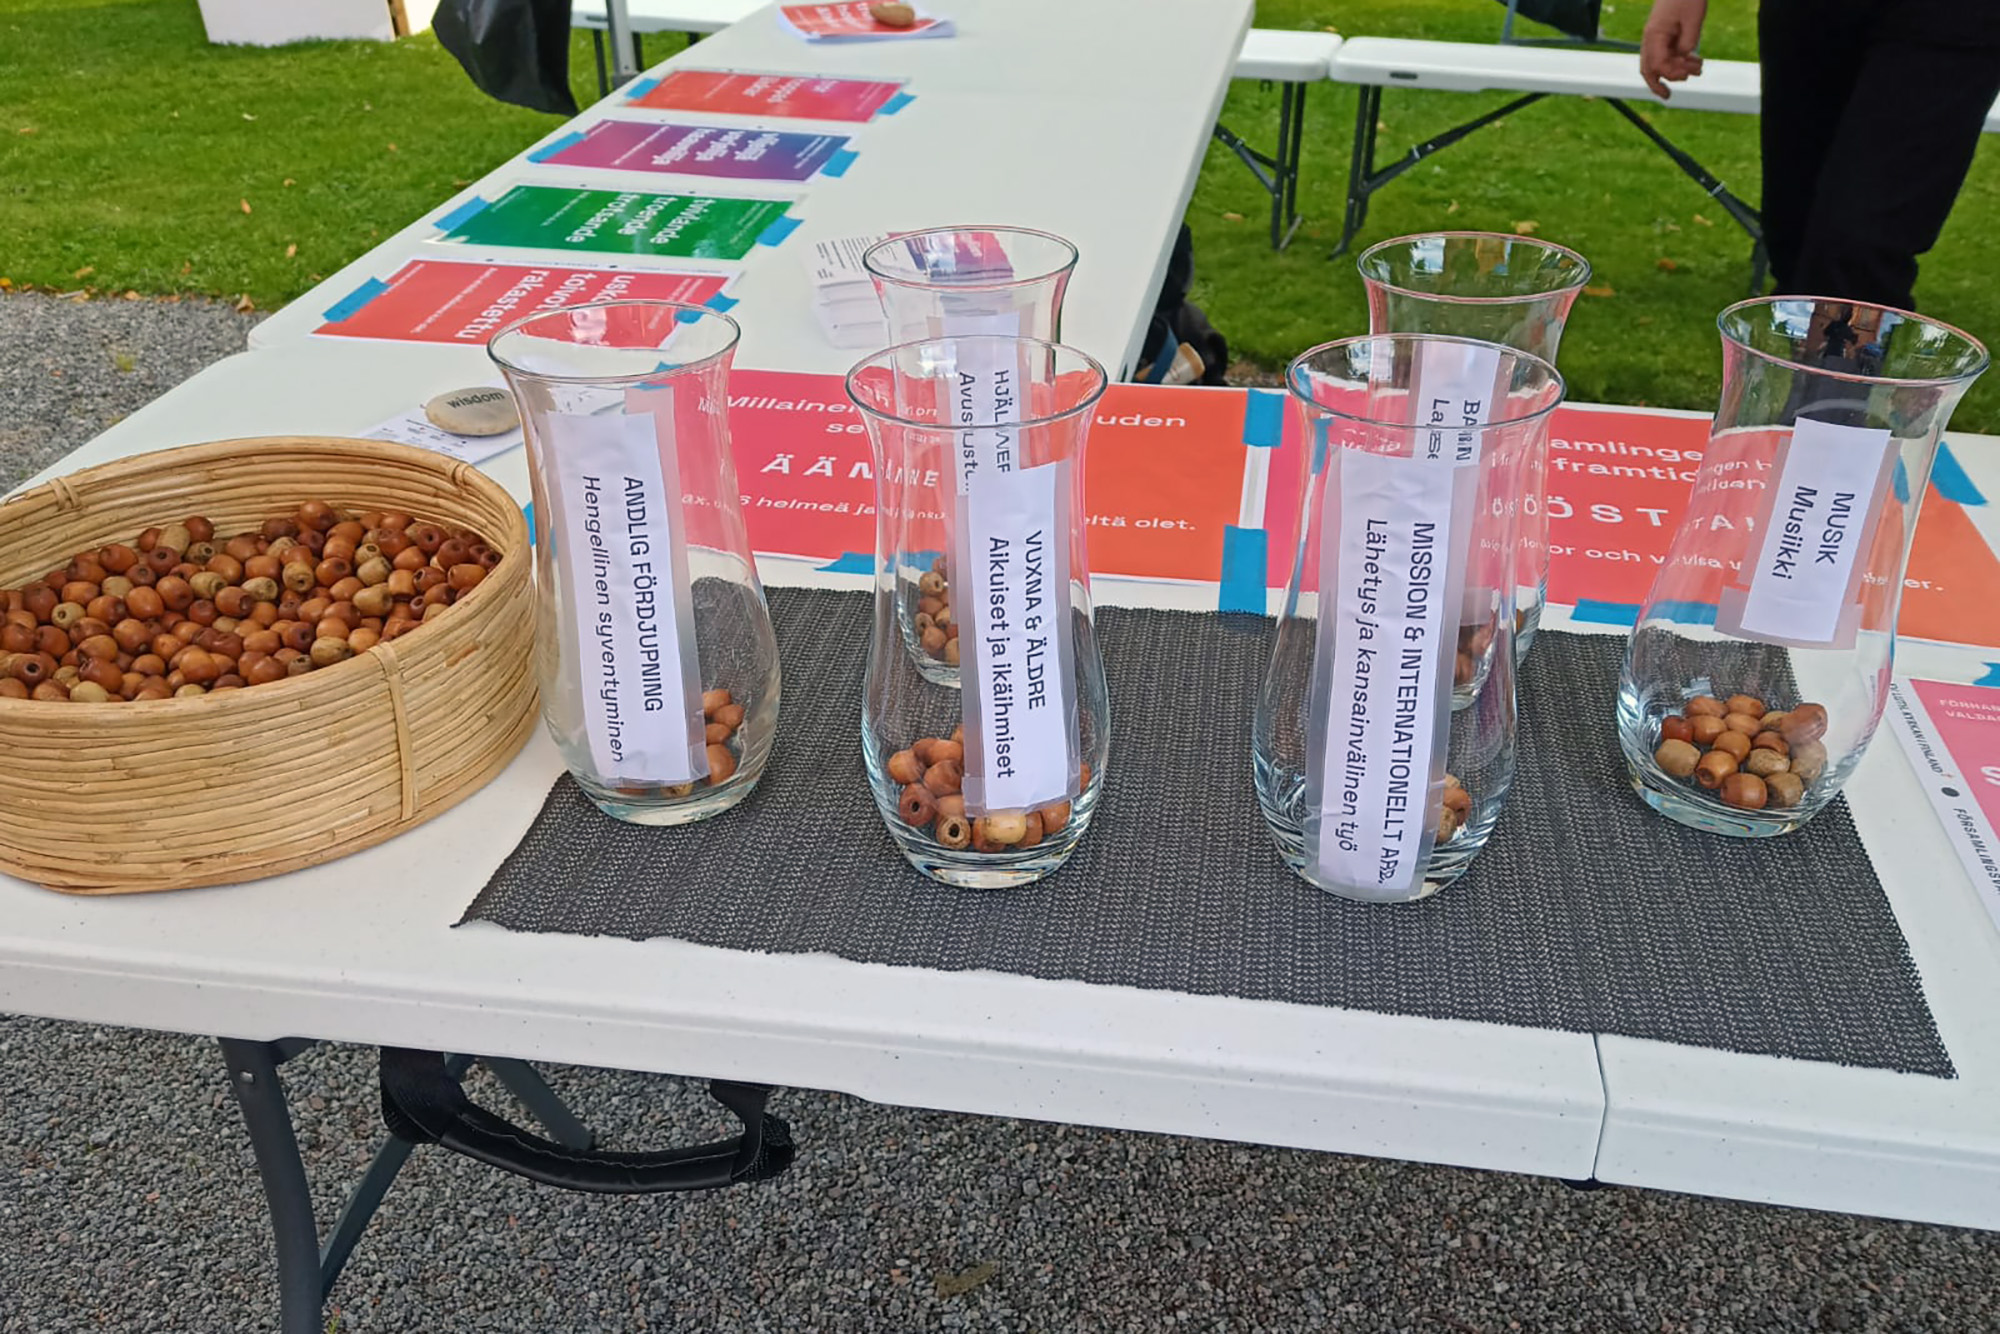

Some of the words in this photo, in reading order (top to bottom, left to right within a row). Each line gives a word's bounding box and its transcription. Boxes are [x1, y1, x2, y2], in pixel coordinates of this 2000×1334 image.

[454, 269, 550, 339] rakastettu
[447, 391, 506, 409] wisdom
[1096, 413, 1186, 427] uden
[582, 475, 610, 606] Hengellinen
[623, 476, 649, 556] ANDLIG
[756, 497, 849, 514] helmeä
[1134, 517, 1197, 531] olet.
[1772, 485, 1818, 580] Musiikki
[1815, 492, 1855, 565] MUSIK
[989, 537, 1010, 631] Aikuiset
[1025, 530, 1042, 611] VUXNA
[1359, 518, 1388, 615] Lähetys
[1406, 522, 1435, 620] MISSION
[1585, 548, 1641, 562] och
[632, 562, 663, 712] FÖRDJUPNING
[987, 638, 1010, 657] ja
[1025, 617, 1042, 631] &
[1356, 618, 1374, 640] ja
[1404, 626, 1425, 642] &
[595, 612, 624, 763] syventyminen
[1027, 637, 1047, 710] ÄLDRE
[992, 663, 1015, 778] ikäihmiset
[1342, 648, 1378, 814] kansainvälinen
[1383, 649, 1422, 842] INTERNATIONELLT
[1335, 819, 1359, 852] työ
